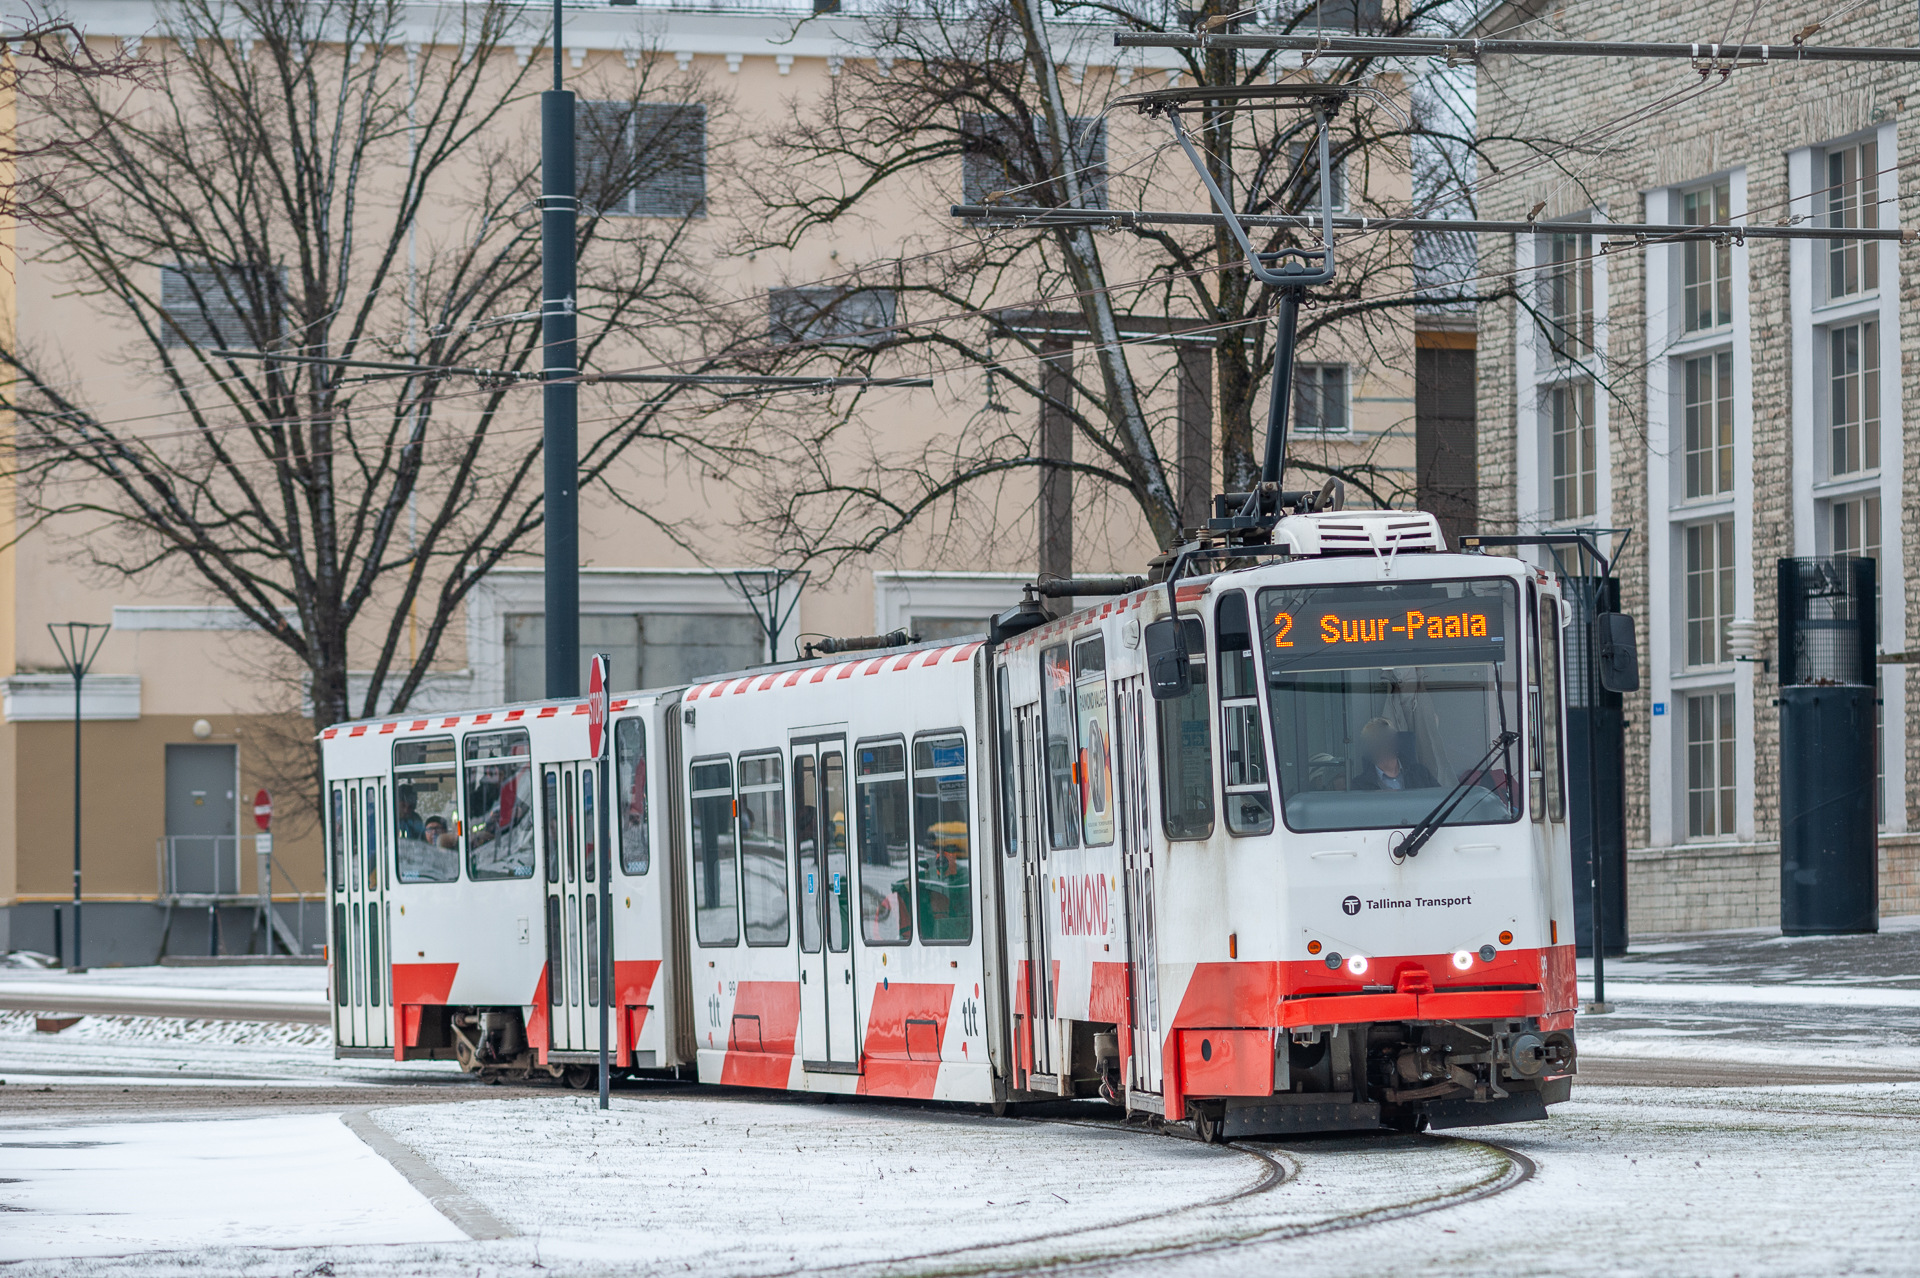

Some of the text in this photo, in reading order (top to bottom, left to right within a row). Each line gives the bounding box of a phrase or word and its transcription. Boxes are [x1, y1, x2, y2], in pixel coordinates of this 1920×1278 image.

[1274, 610, 1487, 648] 2 Suur-Paala
[589, 692, 602, 725] STOP
[1060, 873, 1108, 937] RAIMOND
[1366, 895, 1472, 910] Tallinna Transport
[1541, 955, 1548, 978] 99
